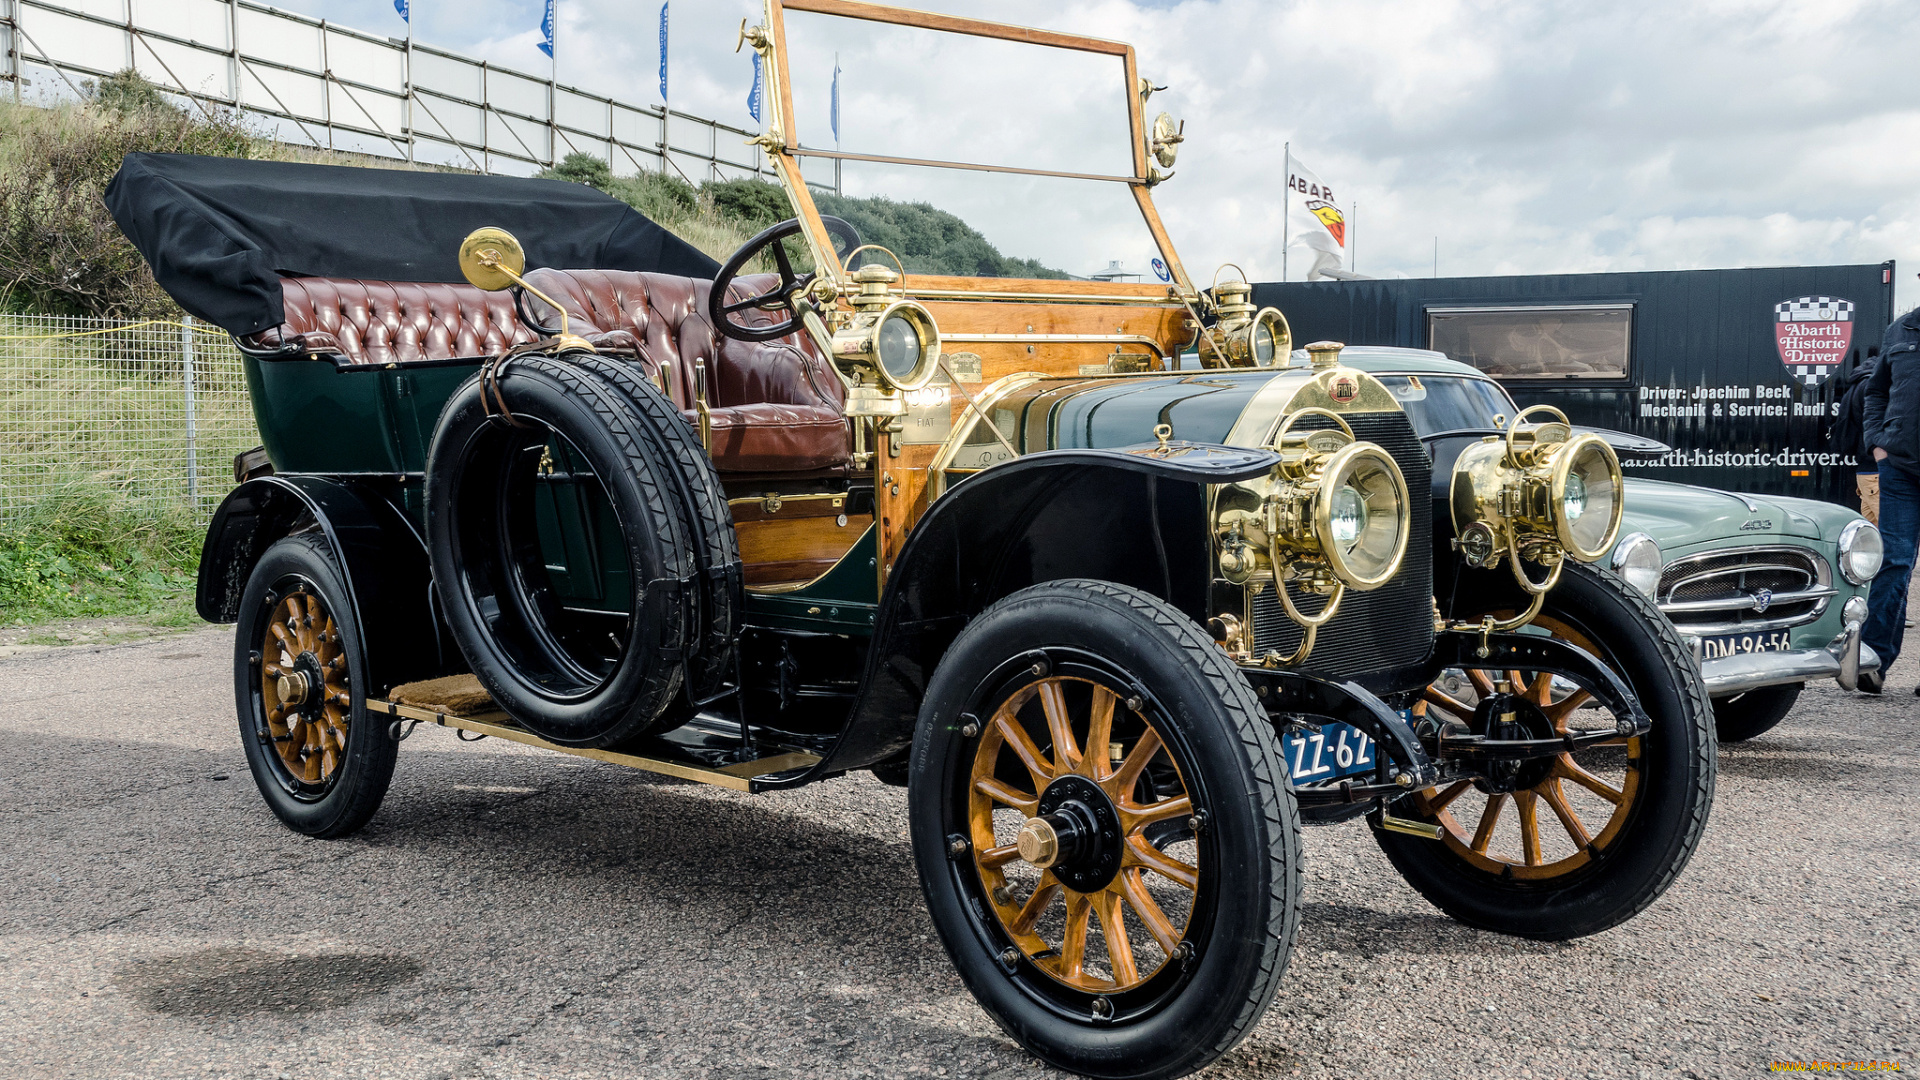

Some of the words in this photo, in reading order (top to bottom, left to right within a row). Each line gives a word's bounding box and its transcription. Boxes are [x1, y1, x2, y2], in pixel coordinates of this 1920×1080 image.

[1784, 323, 1841, 336] Abarth
[1779, 336, 1846, 349] Historic
[1784, 349, 1839, 362] Driver
[1337, 384, 1352, 397] FIAT
[1640, 386, 1687, 400] Driver:
[1691, 385, 1750, 399] Joachim
[1755, 385, 1791, 399] Beck
[1640, 403, 1706, 417] Mechanik
[1712, 403, 1723, 417] &
[1728, 402, 1788, 417] Service:
[1793, 402, 1825, 417] Rudi
[917, 418, 934, 427] FIAT
[1740, 519, 1773, 531] 403
[1704, 633, 1791, 659] DM-96-56
